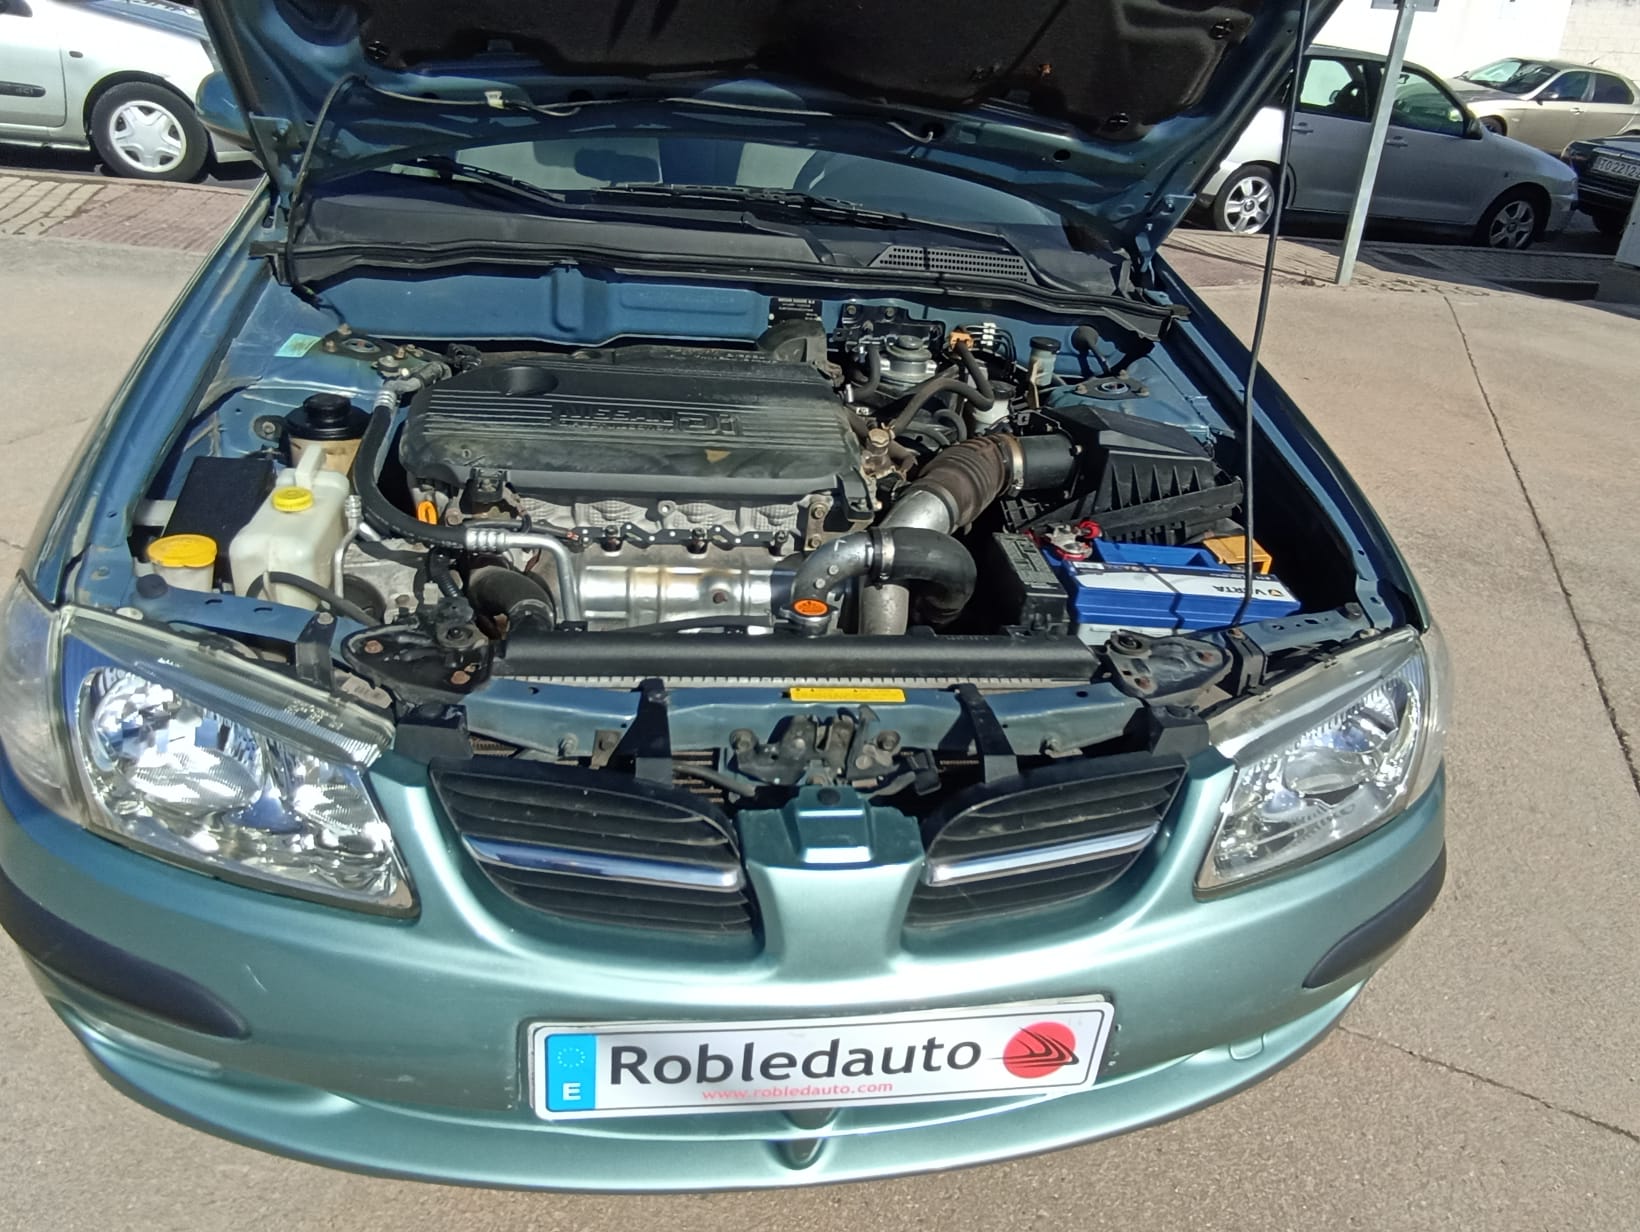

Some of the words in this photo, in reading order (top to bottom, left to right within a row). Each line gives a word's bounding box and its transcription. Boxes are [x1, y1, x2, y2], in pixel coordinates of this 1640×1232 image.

[611, 1036, 982, 1085] Robledauto
[562, 1082, 582, 1101] E
[702, 1083, 893, 1099] www.robledauto.com
